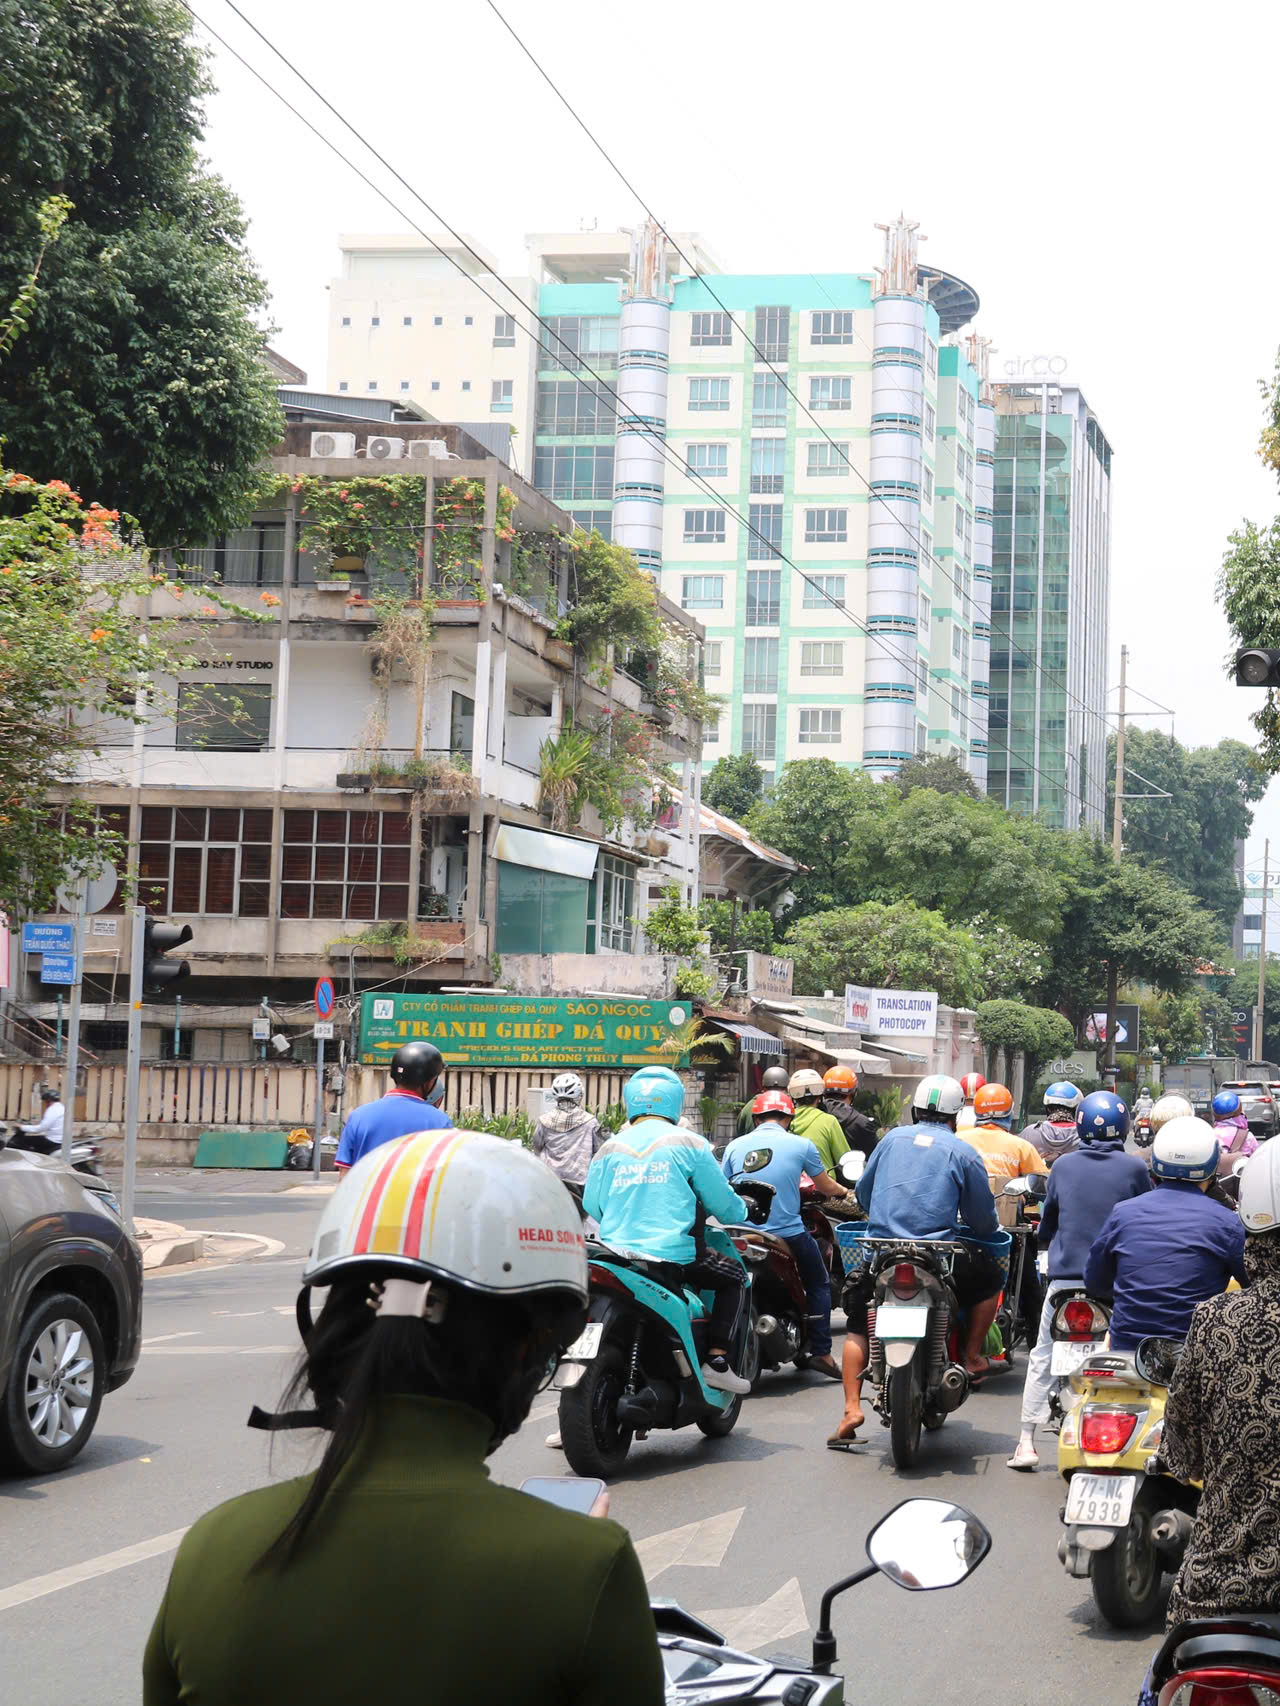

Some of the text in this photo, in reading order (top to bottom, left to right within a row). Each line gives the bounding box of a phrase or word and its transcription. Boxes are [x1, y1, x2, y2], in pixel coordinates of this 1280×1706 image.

[236, 661, 274, 669] STUDIO
[402, 1002, 420, 1012] CTY
[469, 1003, 498, 1013] TRANH
[566, 1003, 599, 1016] SAO
[602, 1004, 652, 1020] NGỌC
[877, 998, 932, 1012] TRANSLATION
[395, 1020, 487, 1038] TRANH
[496, 1018, 563, 1039] GHÉP
[615, 1020, 664, 1041] QUÝ
[879, 1017, 927, 1031] PHOTOCOPY
[541, 1053, 583, 1063] PHONG
[649, 1160, 670, 1172] SM
[518, 1227, 553, 1242] HEAD
[1075, 1500, 1121, 1521] 7938
